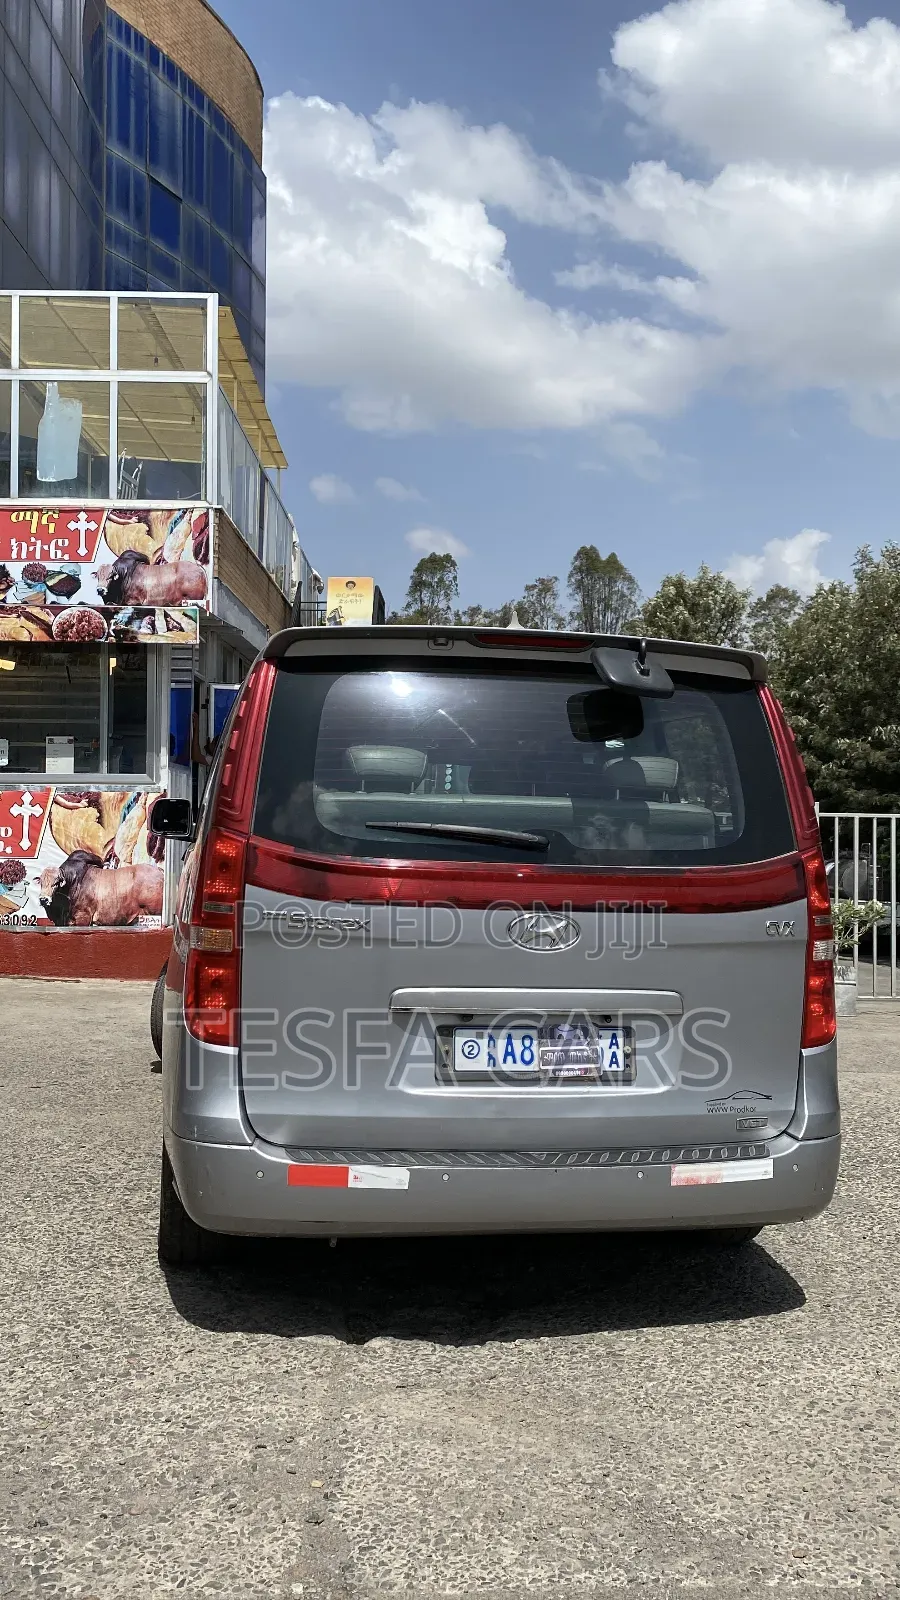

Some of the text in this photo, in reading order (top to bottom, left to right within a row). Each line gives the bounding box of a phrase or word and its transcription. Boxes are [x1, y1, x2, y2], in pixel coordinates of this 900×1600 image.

[10, 536, 69, 561] ክትፎ
[0, 914, 37, 926] 3092
[288, 911, 371, 932] Starex
